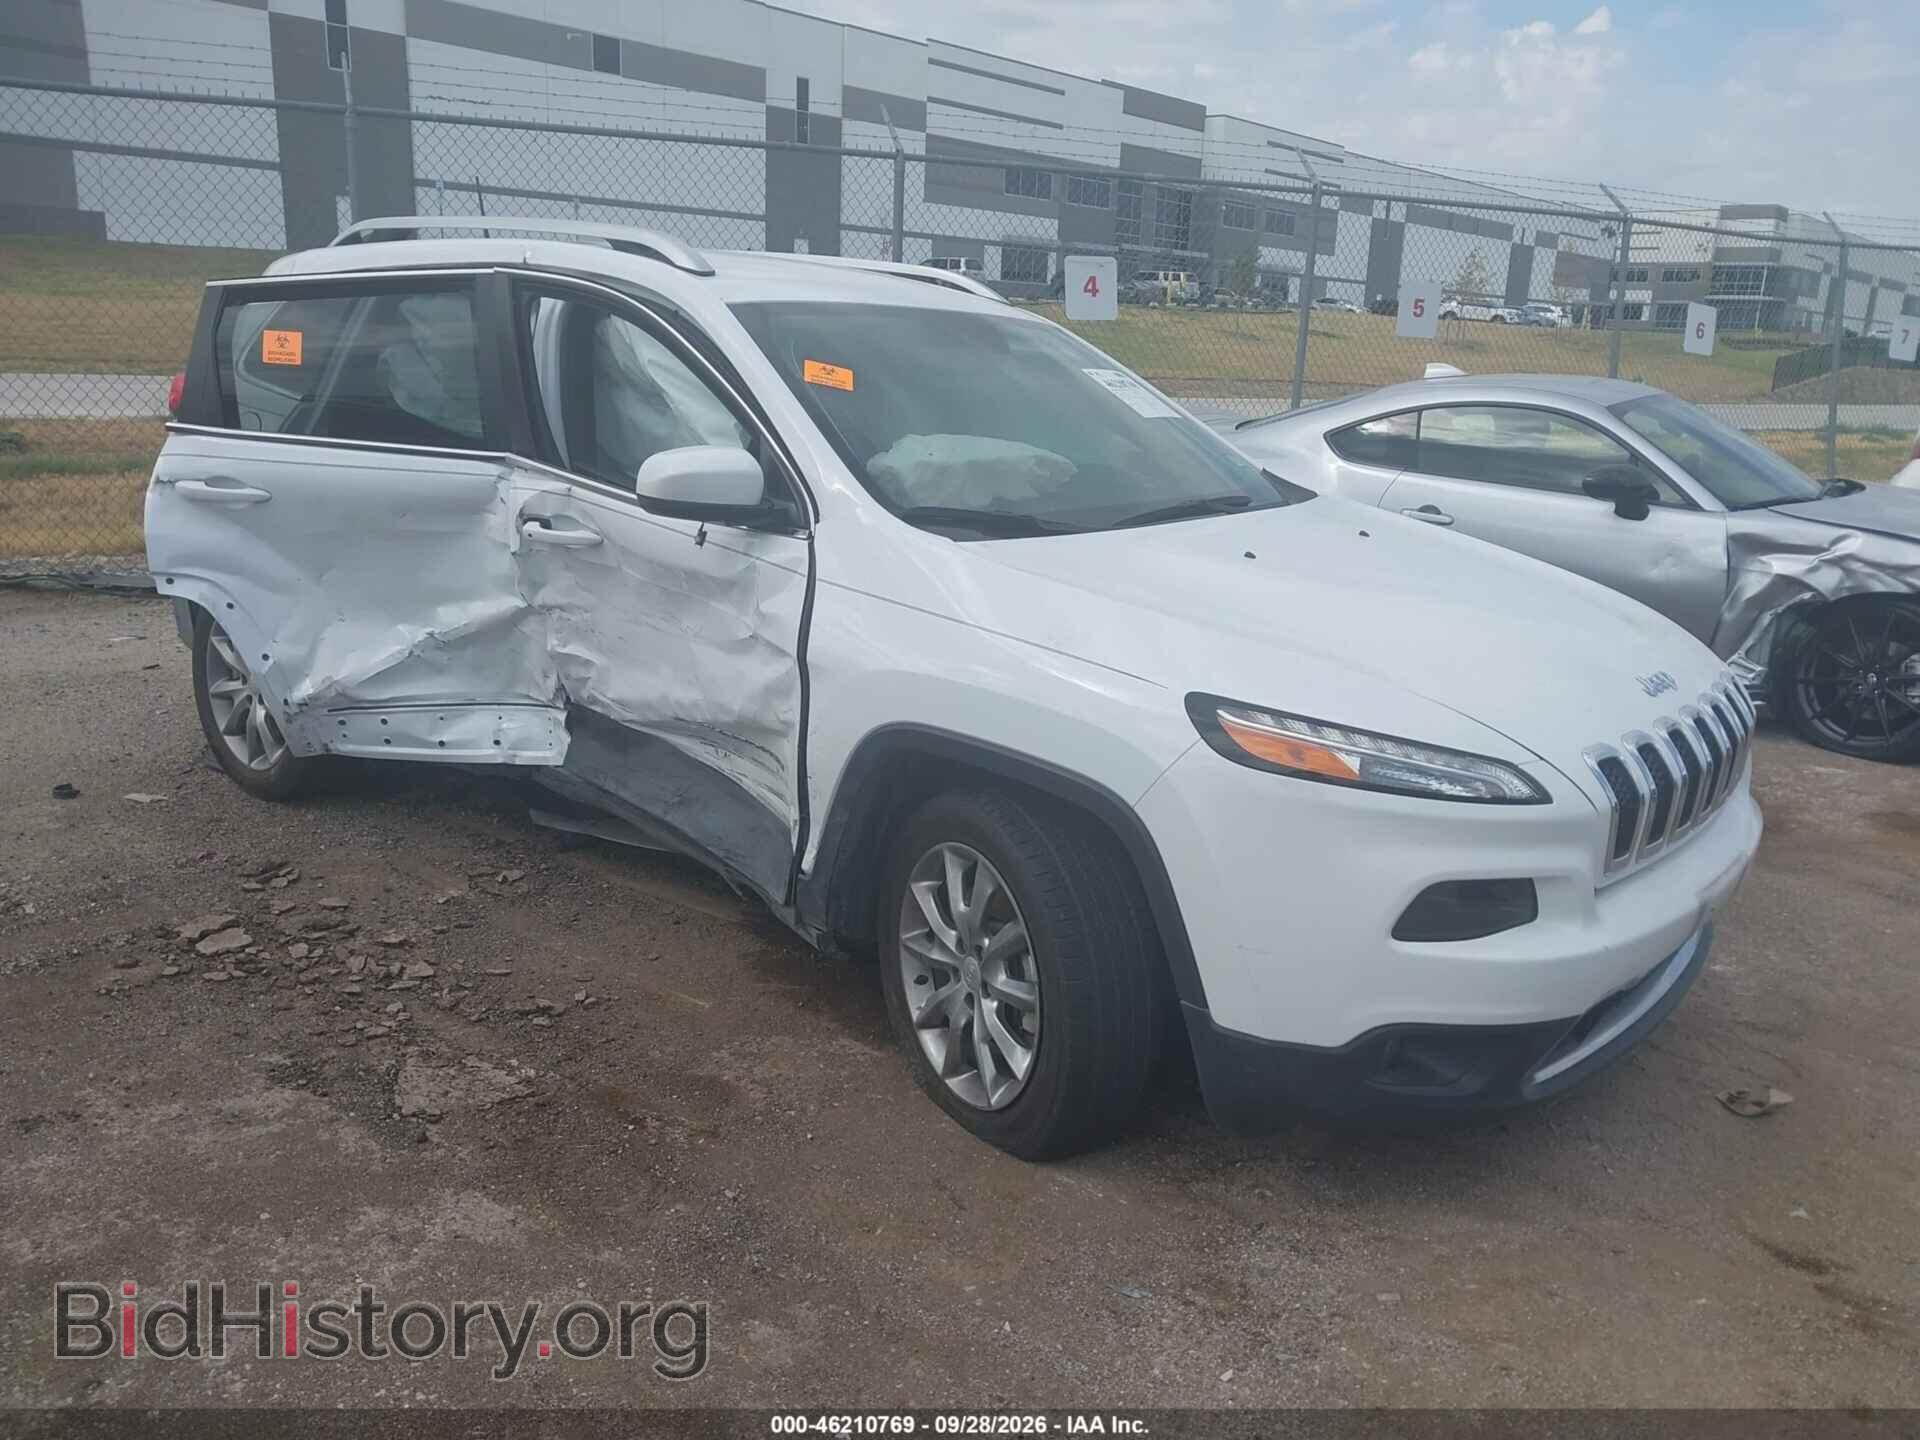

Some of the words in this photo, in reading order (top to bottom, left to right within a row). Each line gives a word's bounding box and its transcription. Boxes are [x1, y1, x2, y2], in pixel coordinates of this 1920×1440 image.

[1083, 275, 1100, 298] 4
[1412, 298, 1425, 318] 5
[1695, 321, 1705, 340] 6
[1902, 329, 1910, 345] 7
